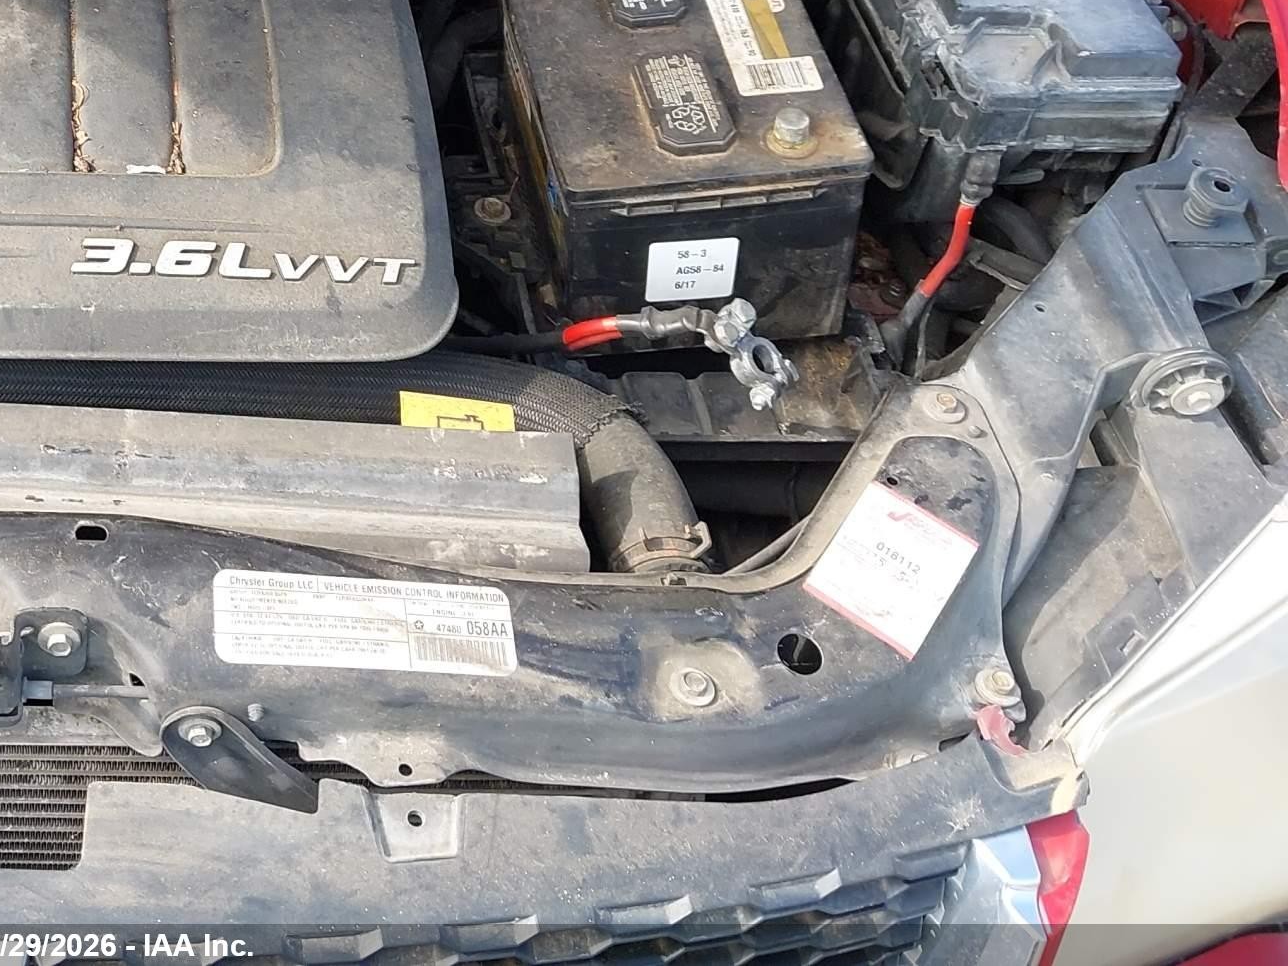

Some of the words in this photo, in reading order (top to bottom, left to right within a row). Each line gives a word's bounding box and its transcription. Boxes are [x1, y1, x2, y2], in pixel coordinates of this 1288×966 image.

[674, 280, 697, 290] 6/17
[229, 575, 265, 588] Chrysler
[268, 577, 295, 590] Group
[297, 579, 313, 590] LLC
[323, 581, 359, 593] VEHICLE
[361, 583, 402, 596] EMISSION
[404, 586, 443, 599] CONTROL
[446, 589, 504, 603] INFORMATION
[466, 620, 508, 636] 058AA
